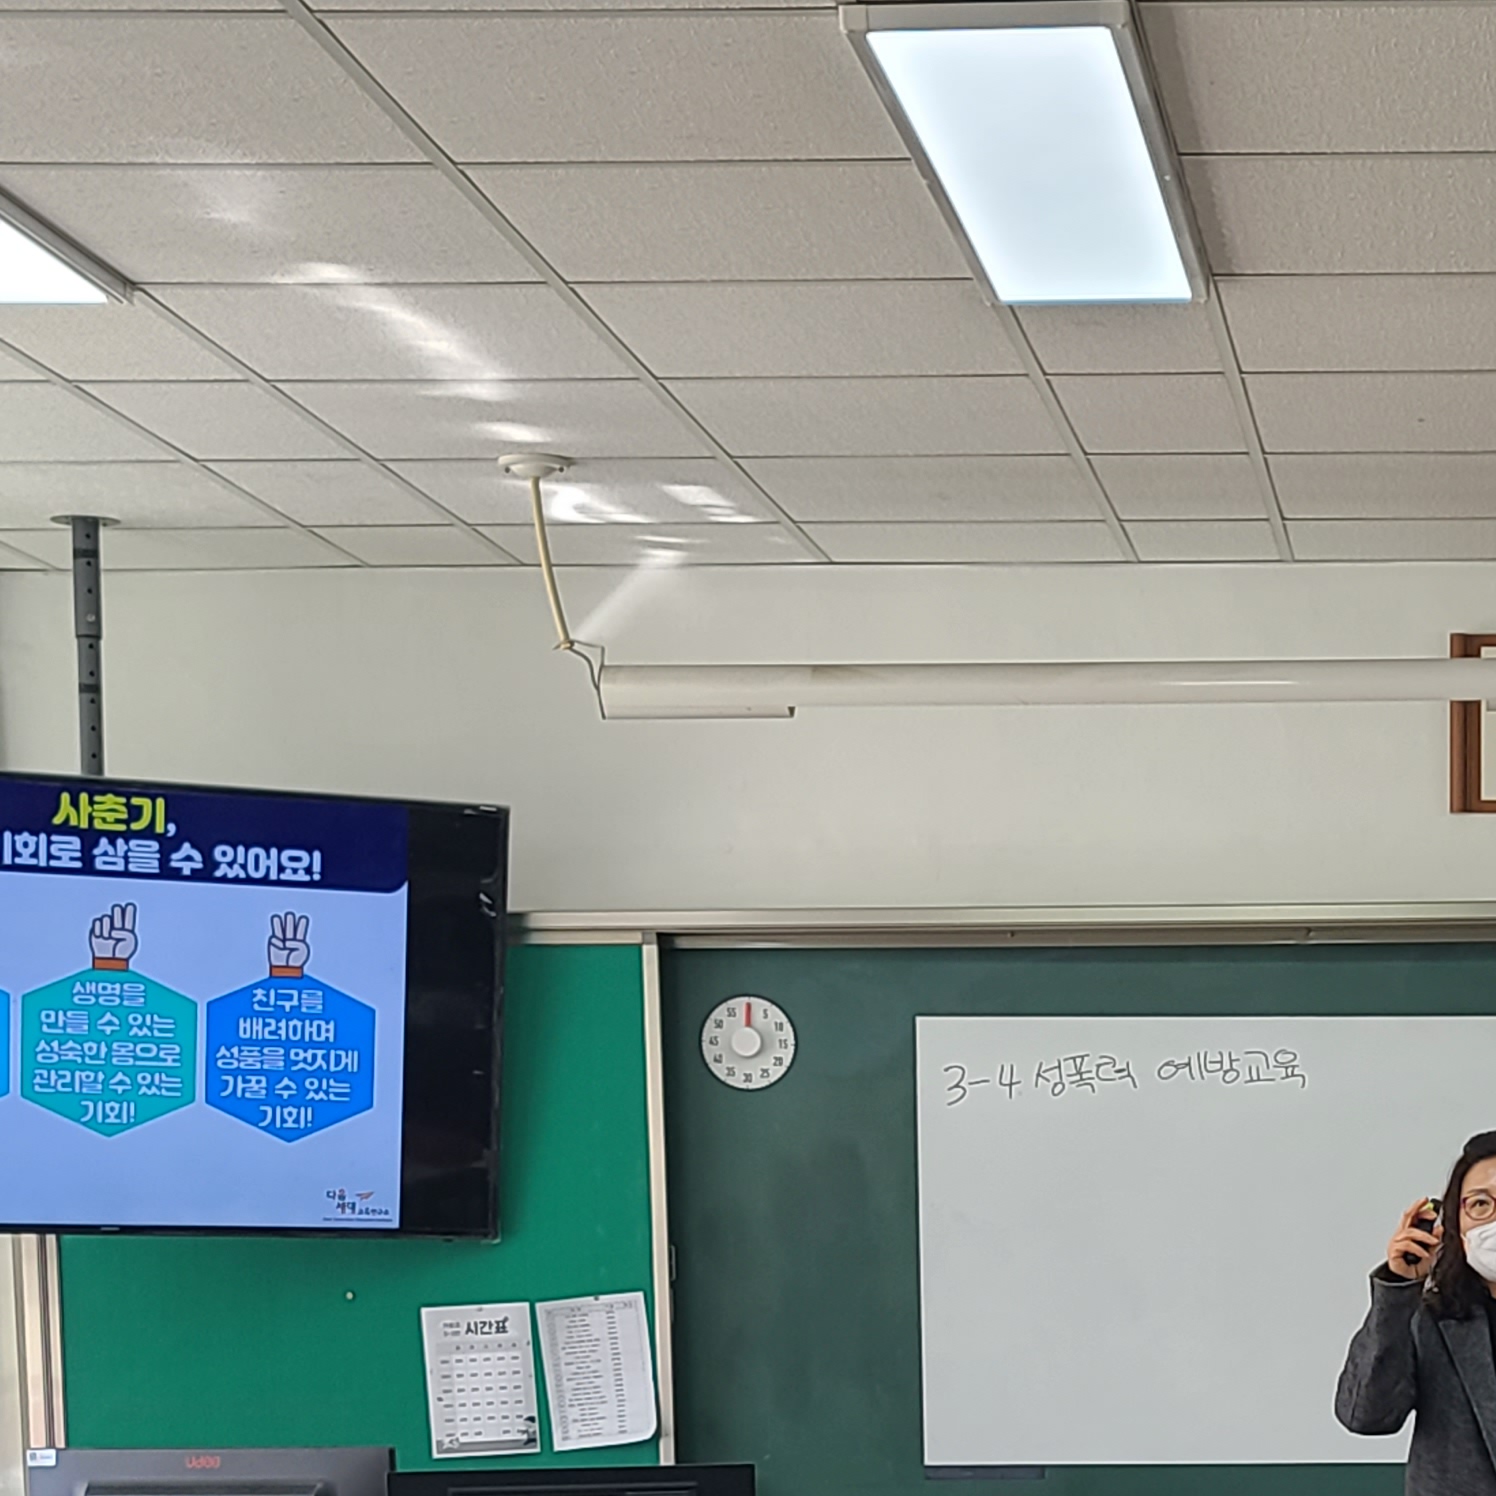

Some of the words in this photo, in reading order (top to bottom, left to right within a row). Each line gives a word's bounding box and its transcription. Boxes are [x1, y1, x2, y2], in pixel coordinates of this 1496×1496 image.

[52, 792, 177, 837] 사춘기,
[92, 837, 161, 873] 삼을
[169, 841, 204, 876] 수
[213, 844, 322, 881] 있어요!
[72, 981, 146, 1007] 생명을
[252, 988, 324, 1014] 친구를
[40, 1010, 89, 1035] 만들
[97, 1011, 121, 1036] 수
[127, 1013, 176, 1038] 있는
[762, 1008, 769, 1020] 5
[238, 1016, 336, 1043] 배려하며
[35, 1040, 108, 1065] 성숙한
[111, 1042, 182, 1067] 몸으로
[215, 1045, 285, 1071] 성품을
[289, 1048, 359, 1073] 멋지게
[33, 1069, 105, 1094] 관리할
[108, 1071, 133, 1095] 수
[136, 1072, 183, 1097] 있는
[1034, 1053, 1138, 1098] 성폭력
[1156, 1048, 1307, 1088] 예방교육
[219, 1075, 268, 1099] 가꿀
[274, 1076, 298, 1100] 수
[304, 1077, 351, 1101] 있는
[79, 1100, 136, 1124] 기회!
[258, 1105, 313, 1129] 기회!
[464, 1316, 510, 1337] 시간표
